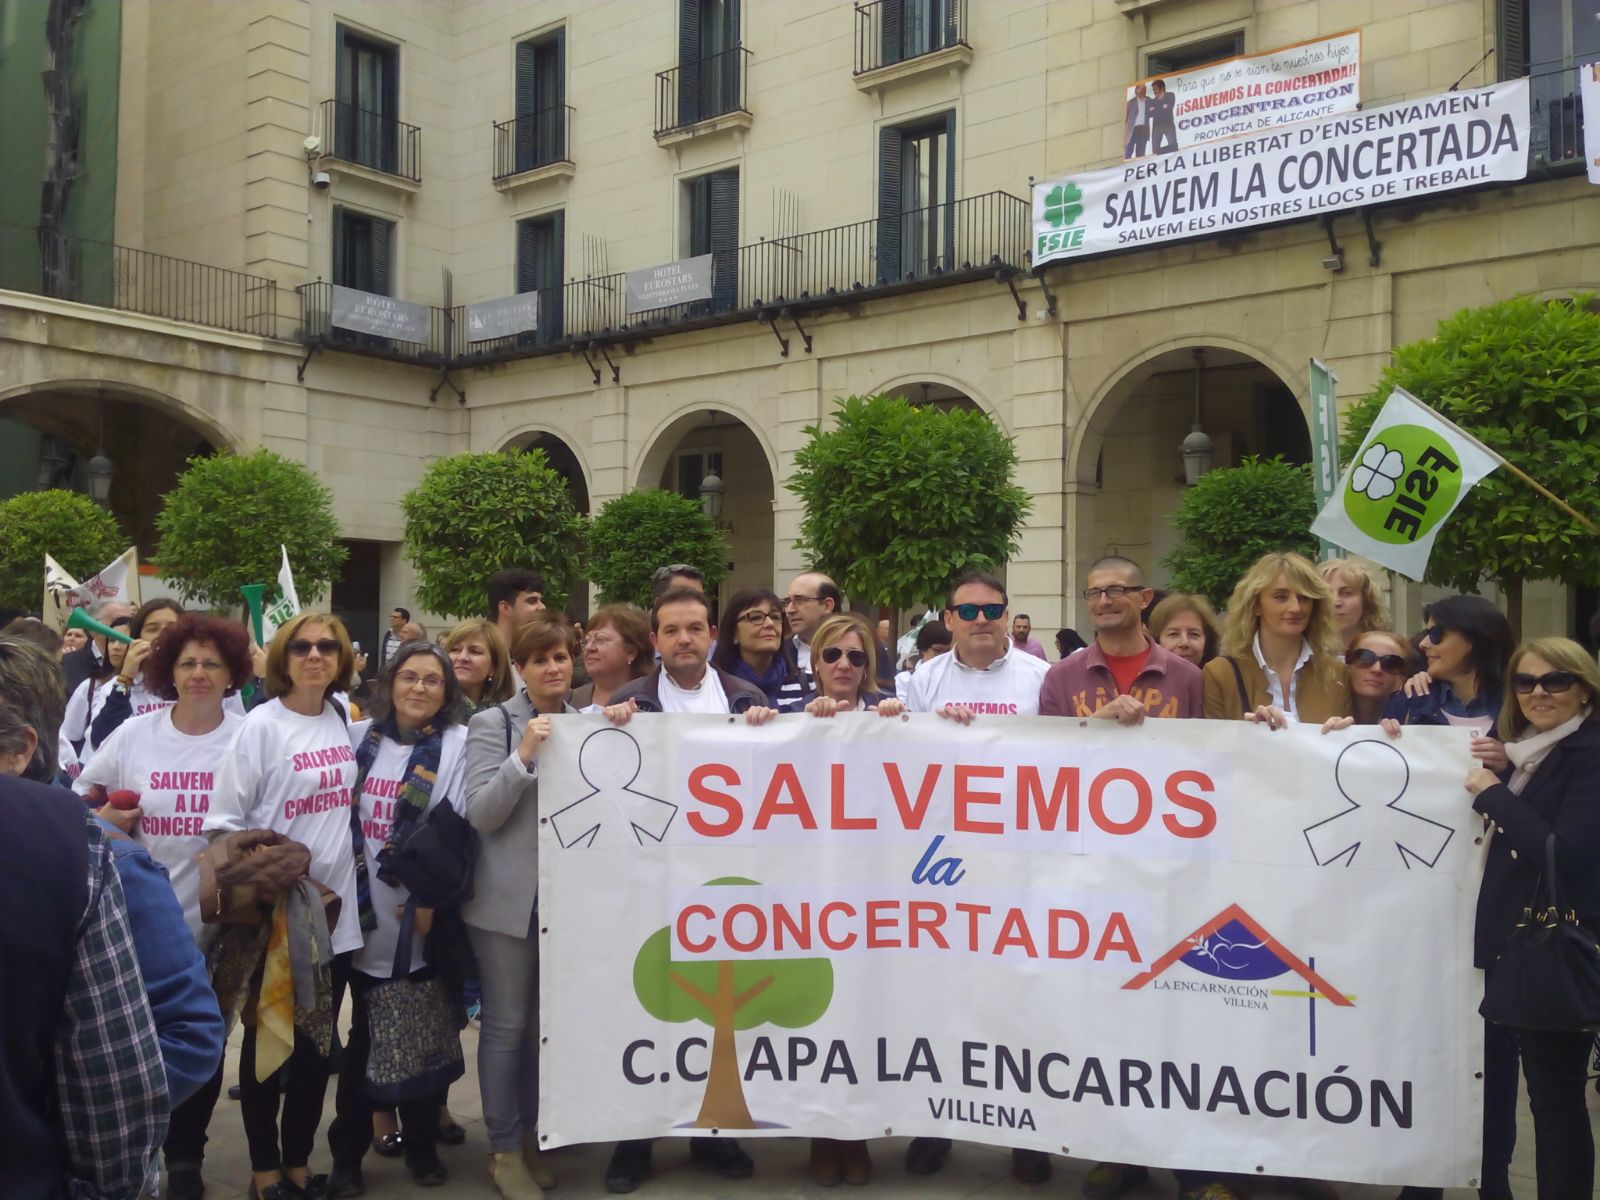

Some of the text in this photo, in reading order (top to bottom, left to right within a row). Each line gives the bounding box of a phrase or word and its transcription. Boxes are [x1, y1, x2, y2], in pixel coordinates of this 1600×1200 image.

[1327, 42, 1350, 64] hijos
[1247, 81, 1262, 98] LA
[1265, 62, 1357, 94] CONCERTADA!!
[1178, 82, 1355, 131] CONCENTRACIÓN
[1123, 91, 1496, 183] PER LA LLIBERTAT D'ENSENYAMENT
[1194, 104, 1335, 142] PROVINCIA DE ALICANTE
[1102, 113, 1520, 229] SALVEM LA CONCERTADA
[1117, 164, 1491, 244] SALVEM ELS NOSTRES LLOCS DE TREBALL
[1037, 228, 1086, 256] FSIE
[643, 272, 694, 292] EUROSTARS
[654, 264, 681, 279] HOTEL
[293, 745, 356, 772] SALVEMOS
[150, 772, 213, 790] SALVEM
[319, 768, 343, 790] A LA
[175, 794, 209, 813] A LA
[372, 800, 382, 819] A
[686, 762, 1217, 839] SALVEMOS
[911, 834, 966, 886] la
[676, 900, 1143, 963] CONCERTADA
[1154, 980, 1268, 998] LA ENCARNACIÓN
[1223, 997, 1269, 1011] VILLENA
[743, 1036, 858, 1085] APA
[877, 1037, 942, 1083] LA
[961, 1040, 1413, 1129] ENCARNACIÓN
[928, 1097, 1037, 1132] VILLENA
